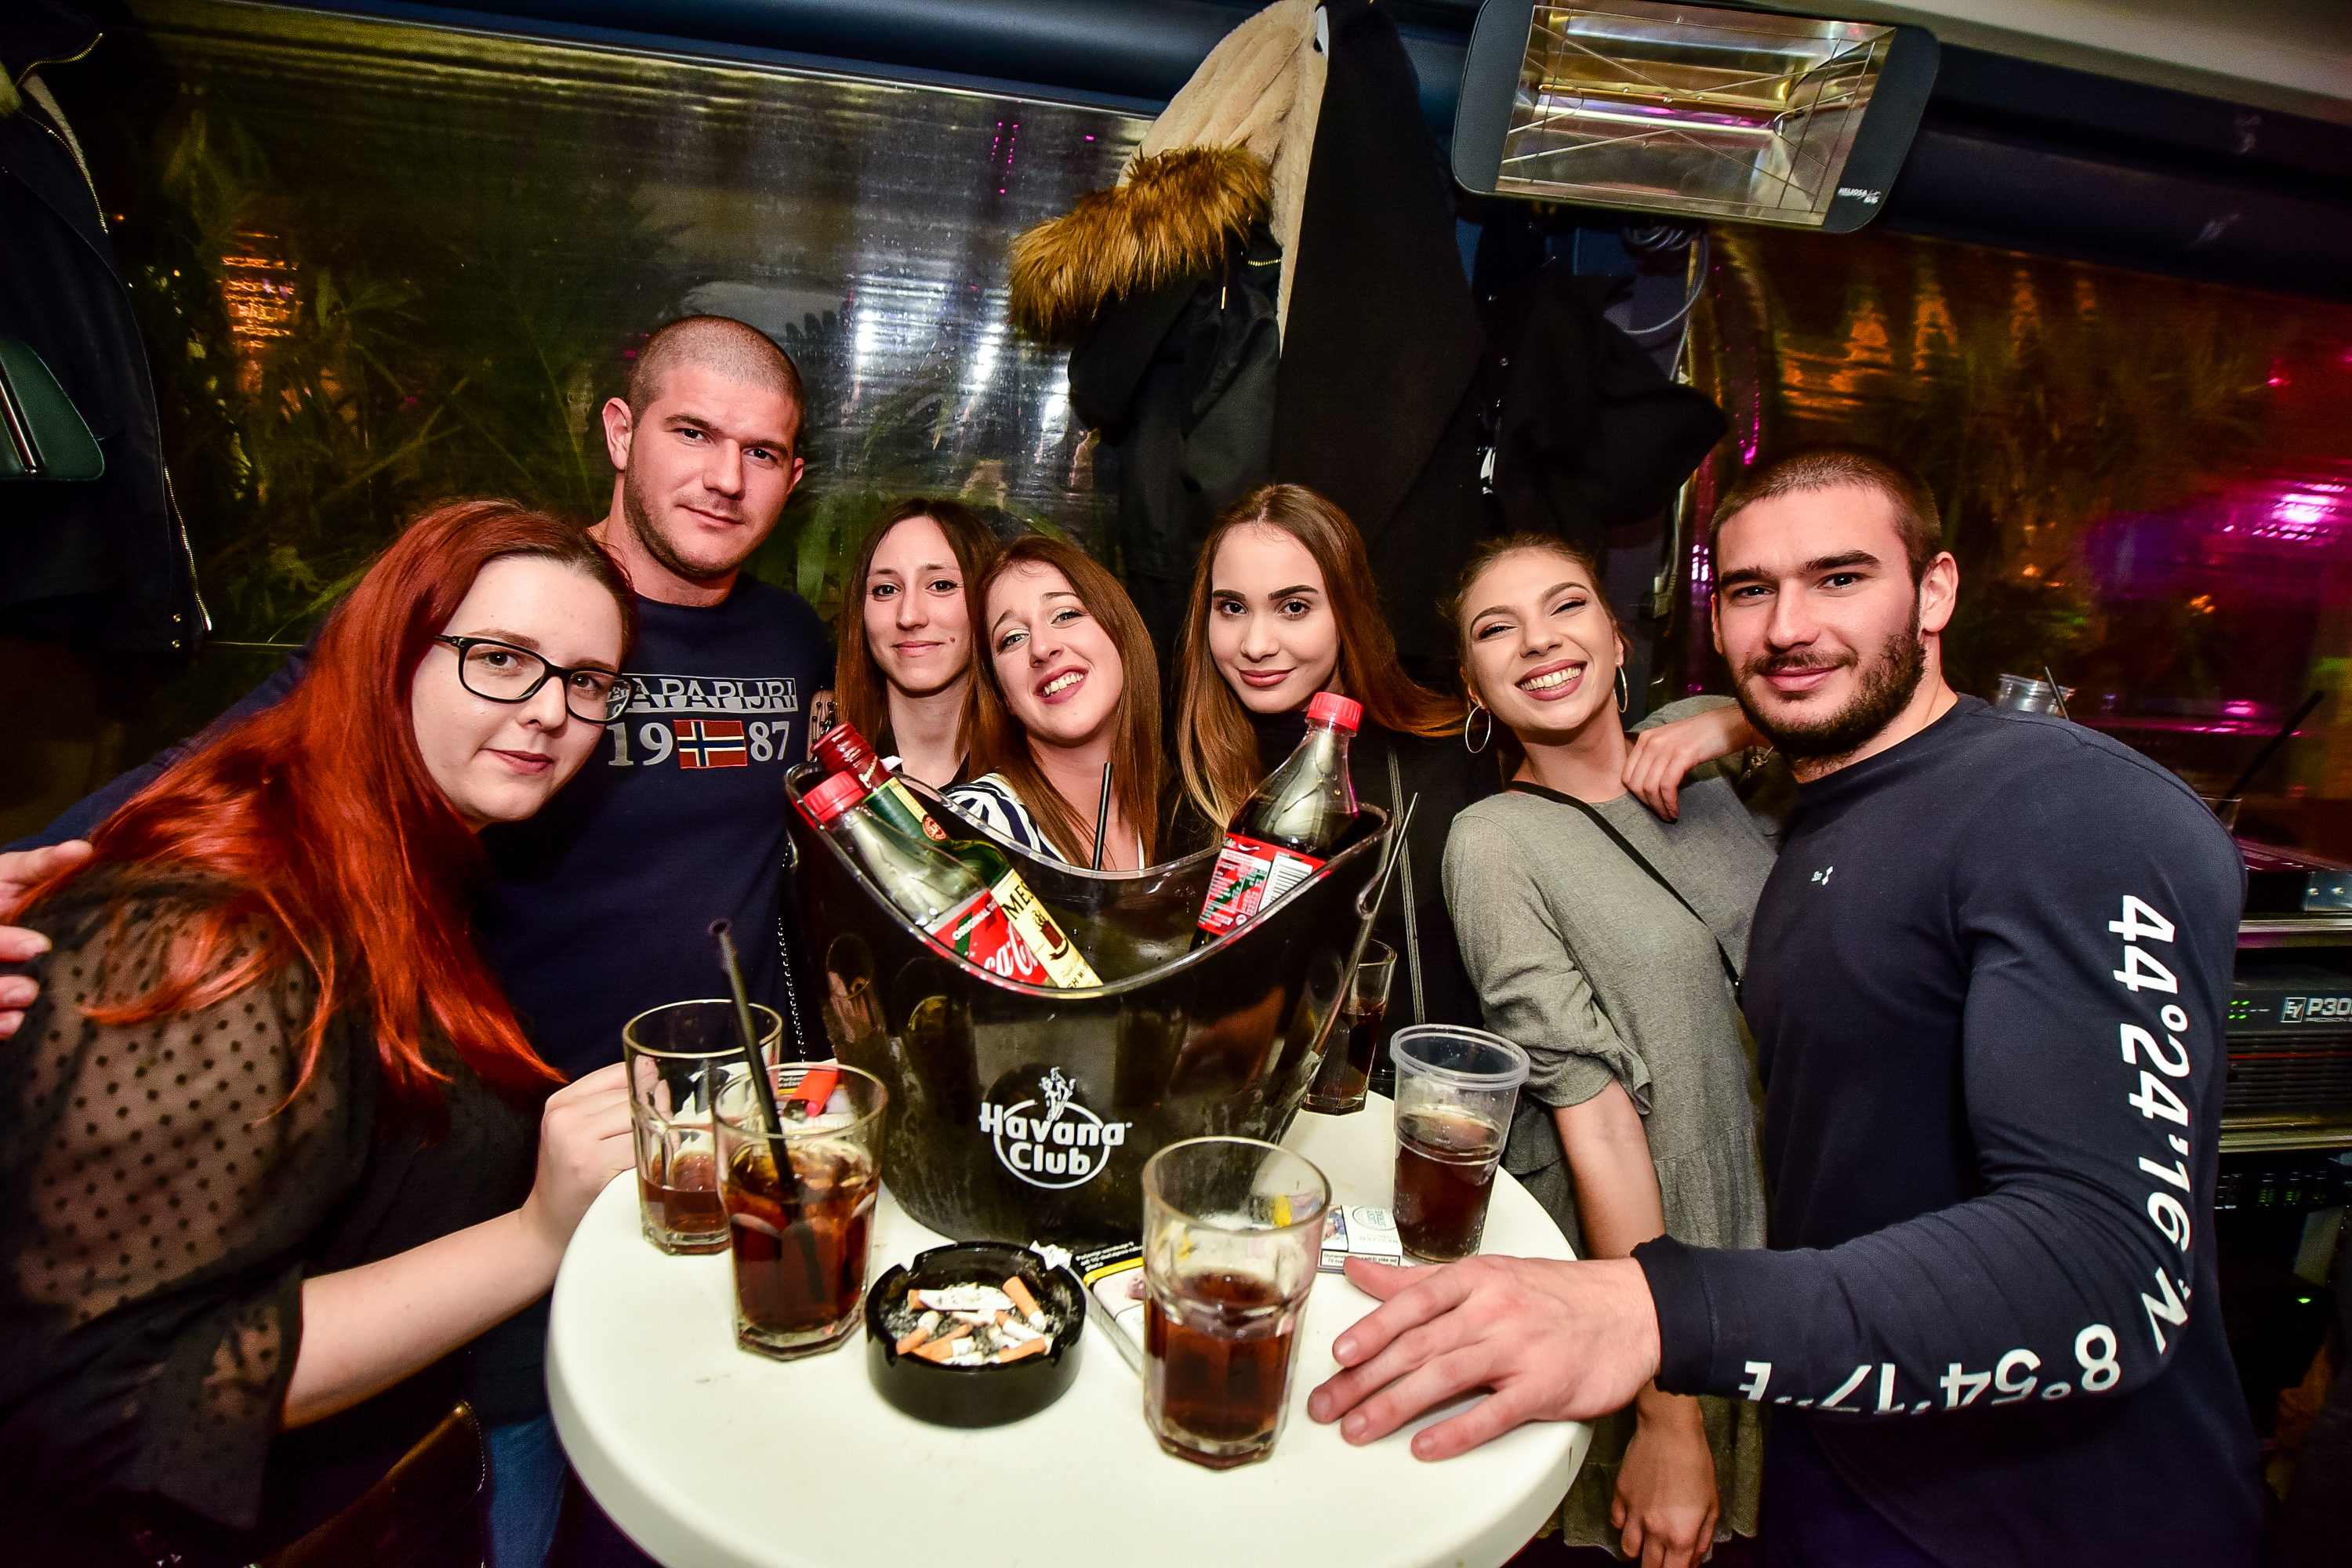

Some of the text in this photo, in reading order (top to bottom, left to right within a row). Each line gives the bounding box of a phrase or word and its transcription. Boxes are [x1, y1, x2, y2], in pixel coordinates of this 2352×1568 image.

[1838, 187, 1867, 196] HELIOSA
[629, 677, 797, 711] APAPIJRI
[606, 720, 789, 766] 19 87
[2305, 997, 2352, 1015] P30
[979, 1102, 1125, 1145] Havana
[1009, 1142, 1091, 1174] Club
